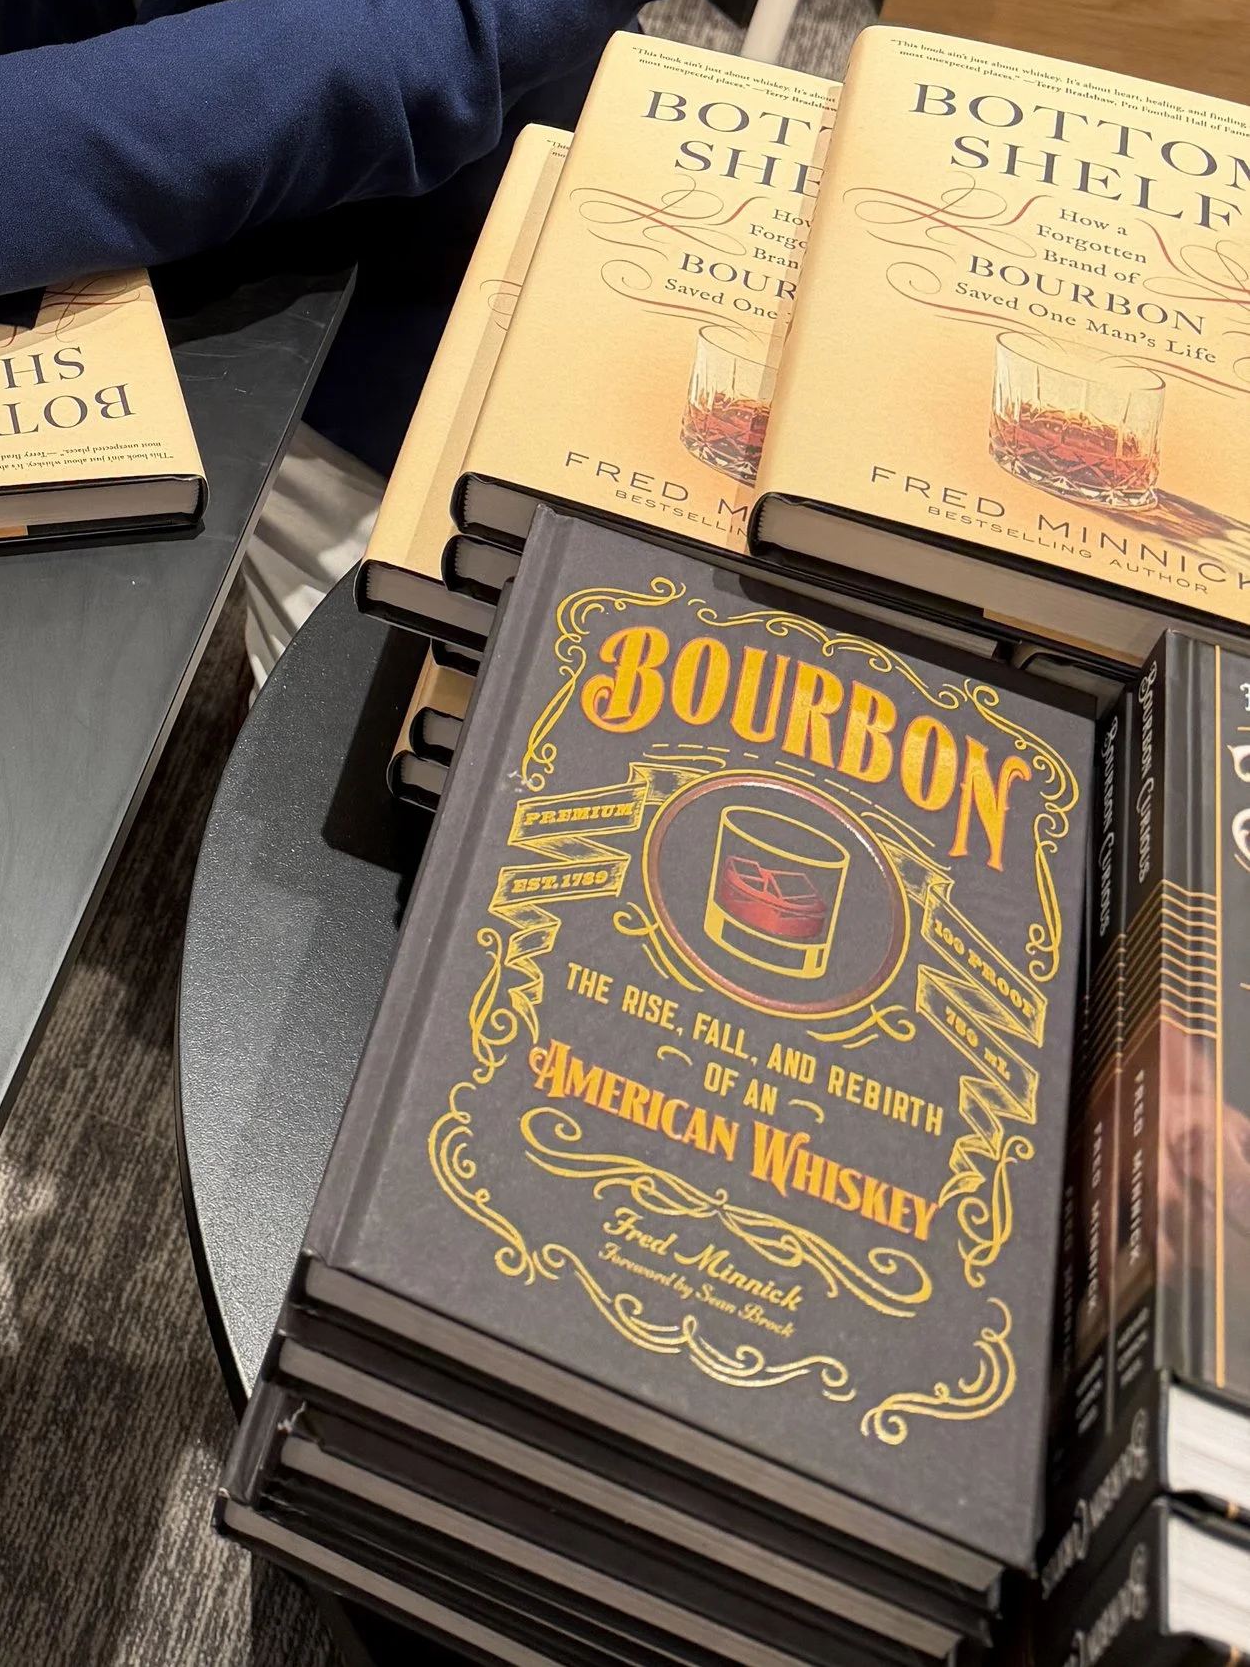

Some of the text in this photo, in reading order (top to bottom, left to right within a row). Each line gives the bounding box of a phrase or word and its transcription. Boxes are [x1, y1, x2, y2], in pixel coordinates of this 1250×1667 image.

[639, 58, 715, 81] most unexpected
[659, 52, 682, 64] book
[705, 64, 722, 74] just
[724, 69, 751, 81] about
[809, 91, 836, 103] about
[900, 50, 923, 59] most
[927, 56, 981, 73] unexpected
[1121, 101, 1138, 111] Pro
[1142, 105, 1182, 122] Football
[1185, 116, 1207, 128] Hall
[921, 44, 945, 54] book
[970, 55, 988, 65] just
[991, 61, 1019, 72] about
[1083, 82, 1111, 94] about
[1188, 107, 1207, 117] and
[1210, 112, 1247, 129] finding
[640, 89, 833, 148] BOT
[950, 136, 1243, 232] SHELF
[1036, 223, 1147, 264] Forgotten
[1059, 207, 1128, 236] How a
[678, 251, 798, 301] BOUR
[752, 246, 799, 270] Bran
[1043, 248, 1141, 285] Brand of
[664, 278, 778, 320] Saved One
[968, 254, 1207, 336] BOURBON
[955, 281, 1019, 311] Saved
[1029, 302, 1077, 327] One
[1165, 339, 1217, 364] Life
[64, 457, 87, 465] about
[92, 443, 139, 453] unexpected
[126, 452, 148, 460] book
[565, 451, 689, 502] FRED
[870, 465, 1006, 518] FRED
[928, 505, 1209, 595] BESTSELLING AUTHOR
[581, 625, 1034, 873] BOURBON
[523, 802, 635, 827] PREMIUM
[511, 870, 609, 894] EST. 1789
[934, 919, 1037, 1019] 100 PROOF
[566, 961, 944, 1135] THE RISE, FALL, AND REBIRTH
[945, 1005, 979, 1048] 750
[702, 1062, 777, 1117] OF AN
[527, 1038, 940, 1242] AMERICAN WHISKEY
[1129, 1068, 1145, 1267] FRED MINNICK
[602, 1206, 804, 1312] Fred Minnick
[598, 1241, 795, 1338] Foreword by Sean Brock
